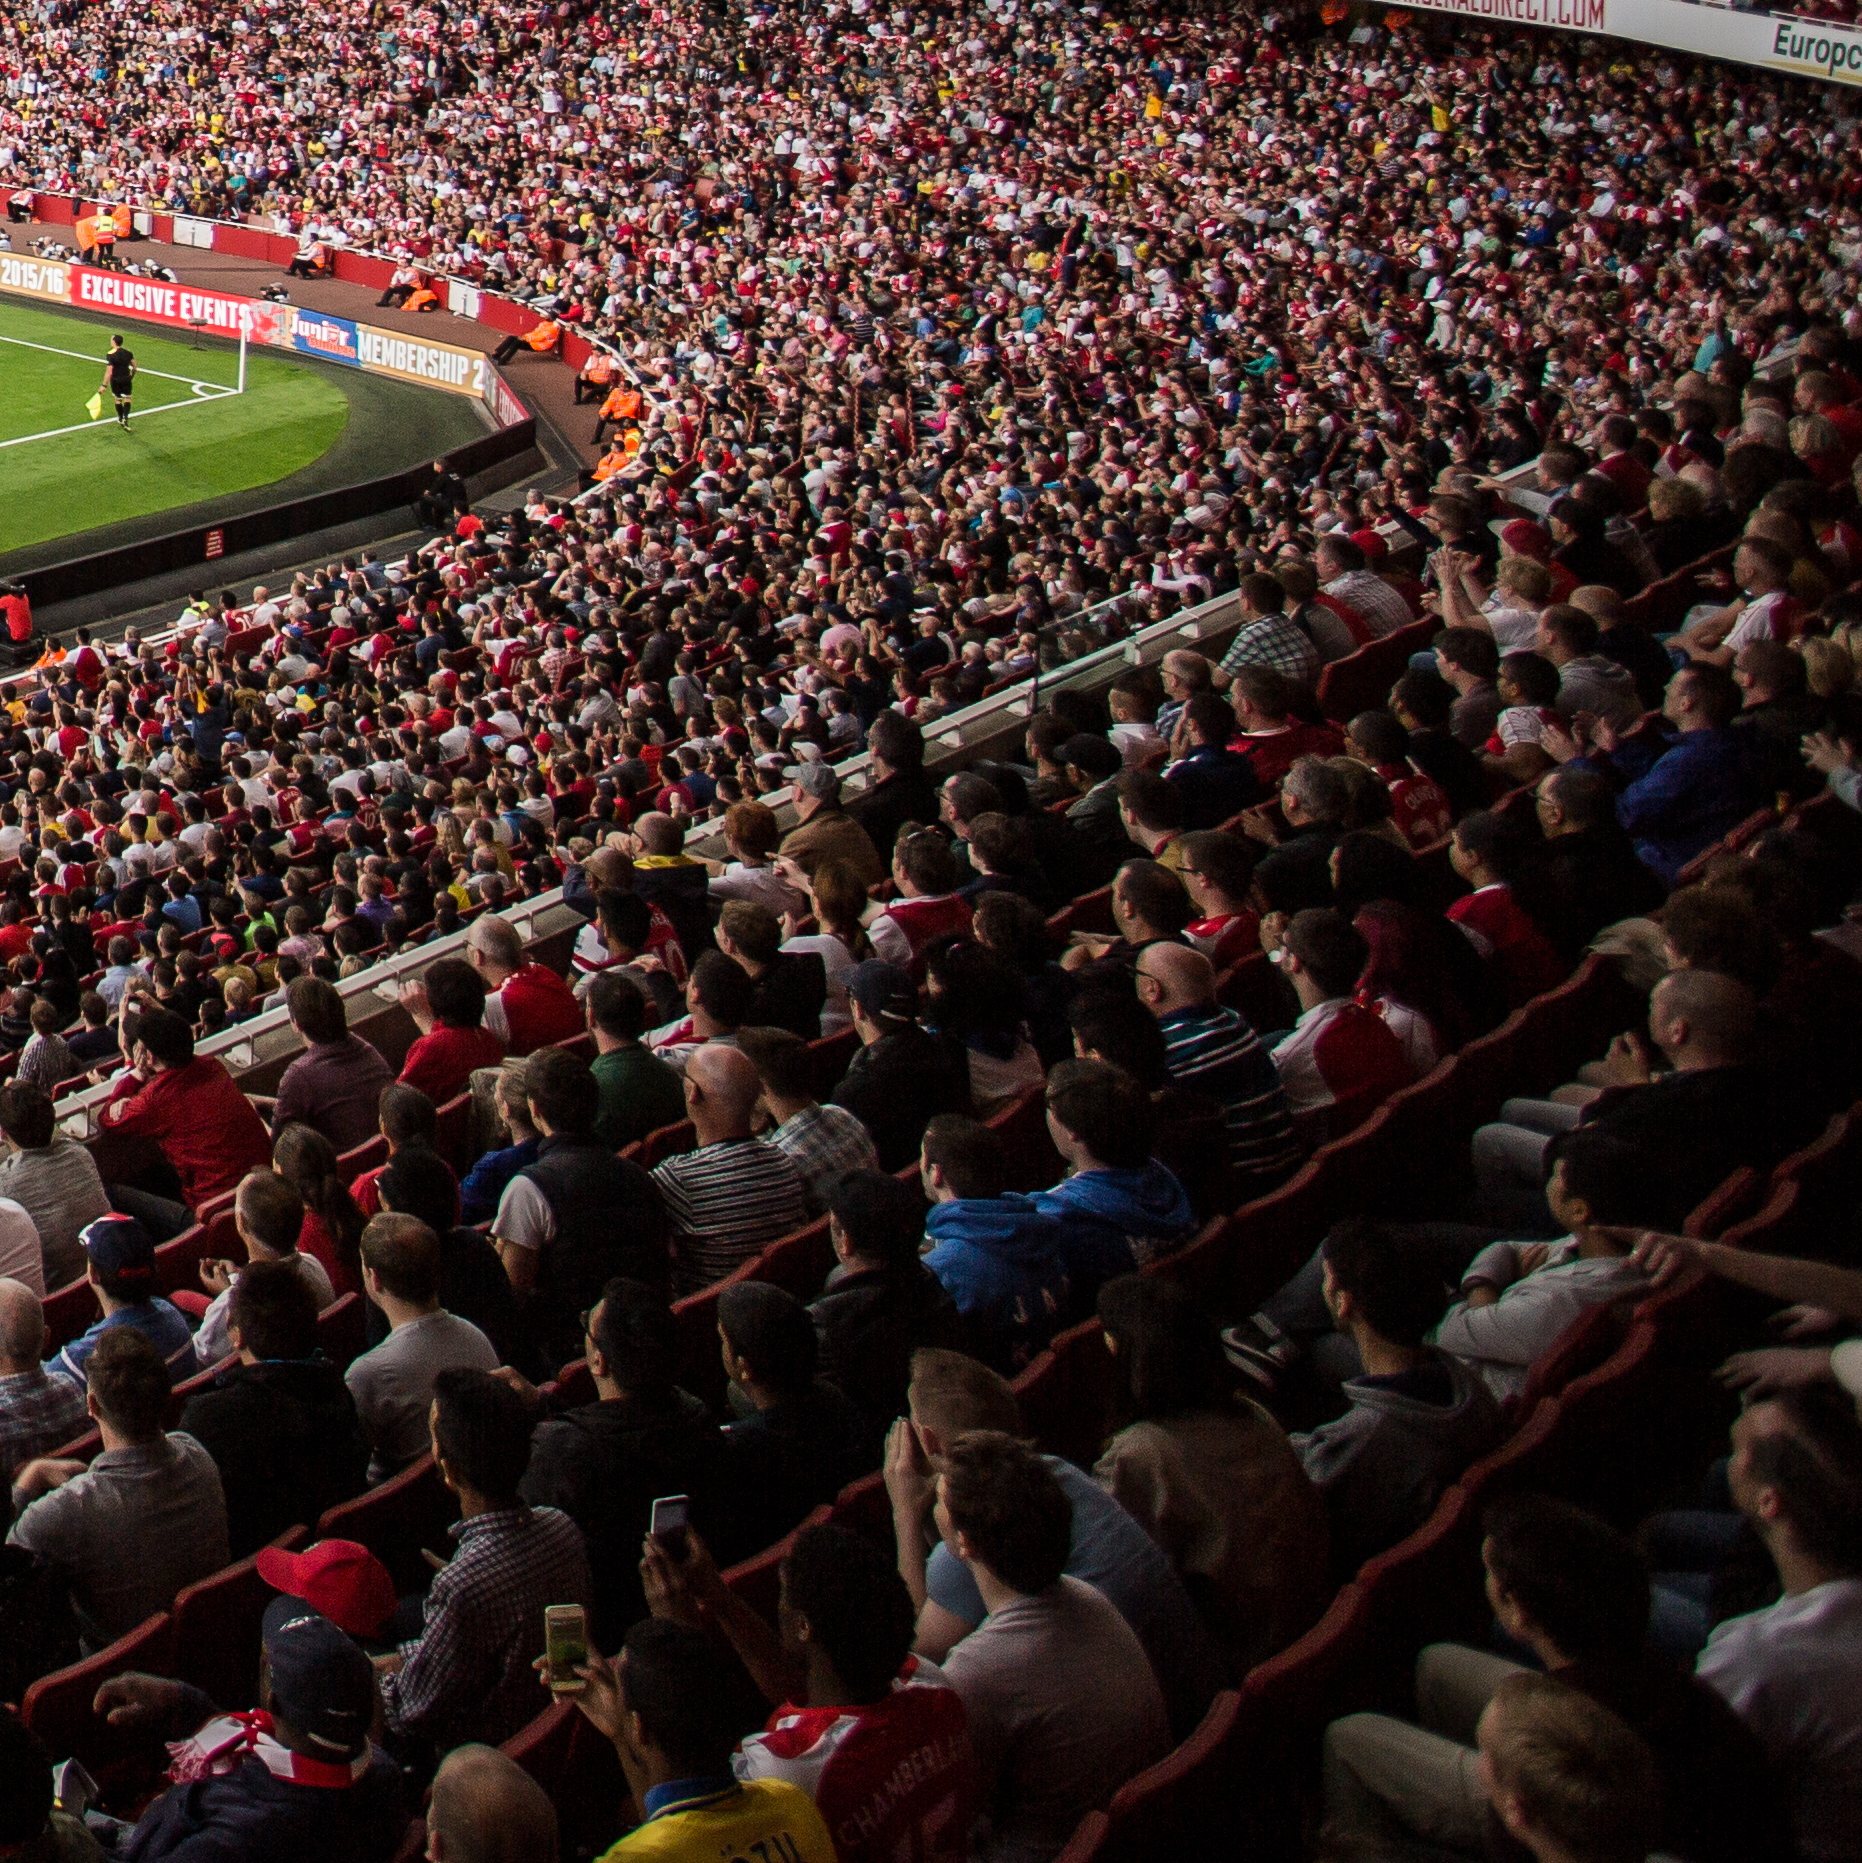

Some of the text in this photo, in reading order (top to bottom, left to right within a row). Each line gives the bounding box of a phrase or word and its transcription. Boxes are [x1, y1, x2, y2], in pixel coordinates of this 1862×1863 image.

[1, 258, 63, 295] 2015/16
[81, 272, 176, 318] EXCLUSIVE
[180, 291, 251, 332] EVENTS
[290, 313, 350, 348] Junior
[358, 328, 470, 387] MEMBERSHIP
